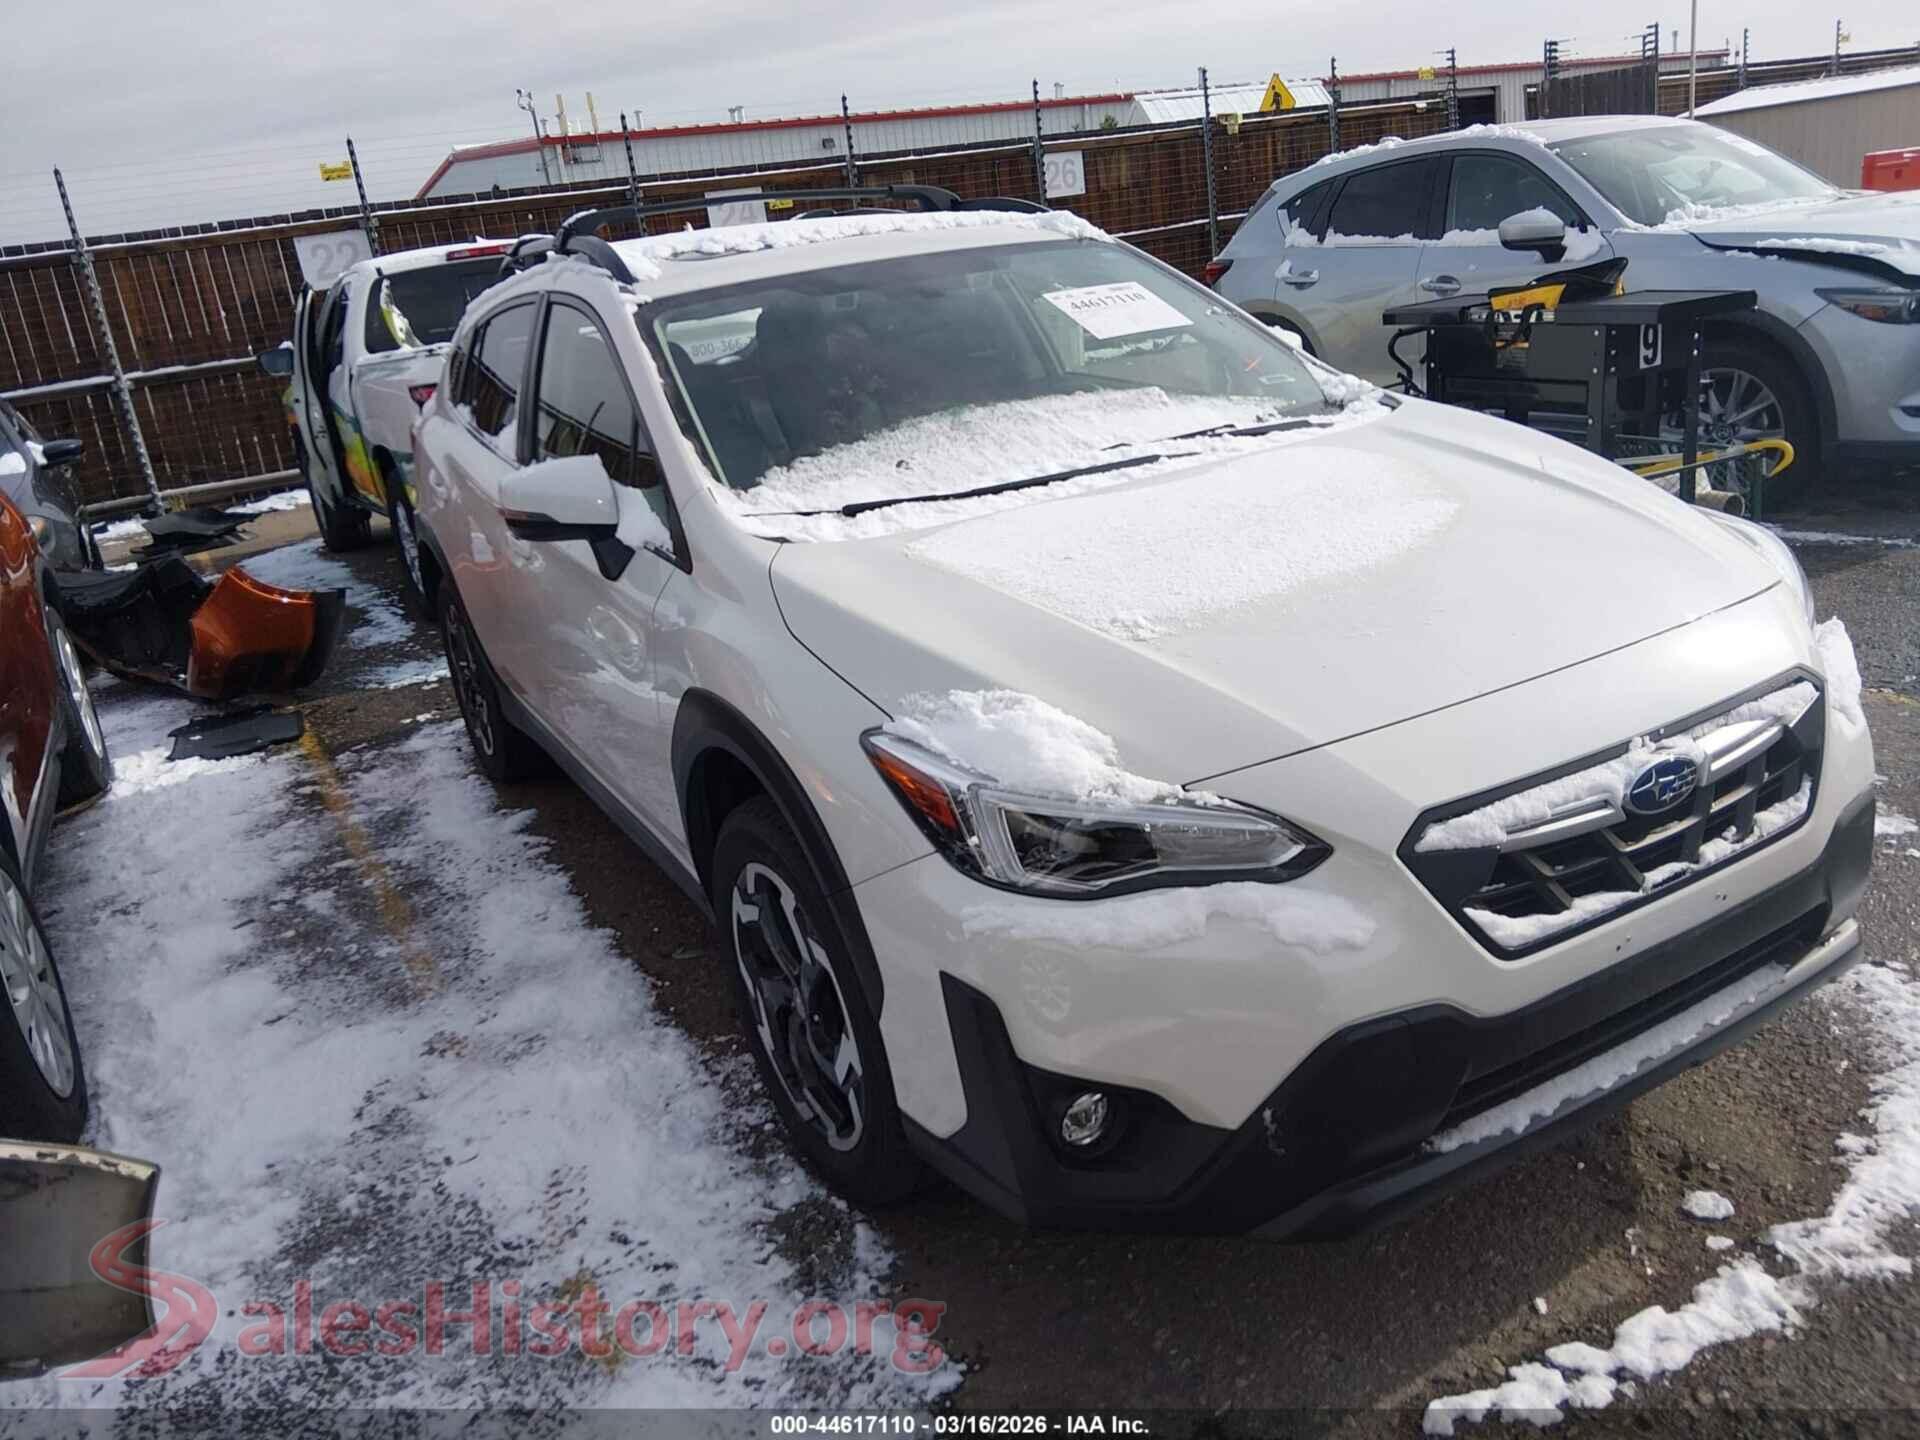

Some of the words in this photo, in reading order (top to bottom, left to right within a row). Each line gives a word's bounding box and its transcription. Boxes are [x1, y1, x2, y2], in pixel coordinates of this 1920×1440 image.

[1046, 158, 1077, 190] 26
[311, 241, 359, 281] 22
[1641, 323, 1659, 366] 9
